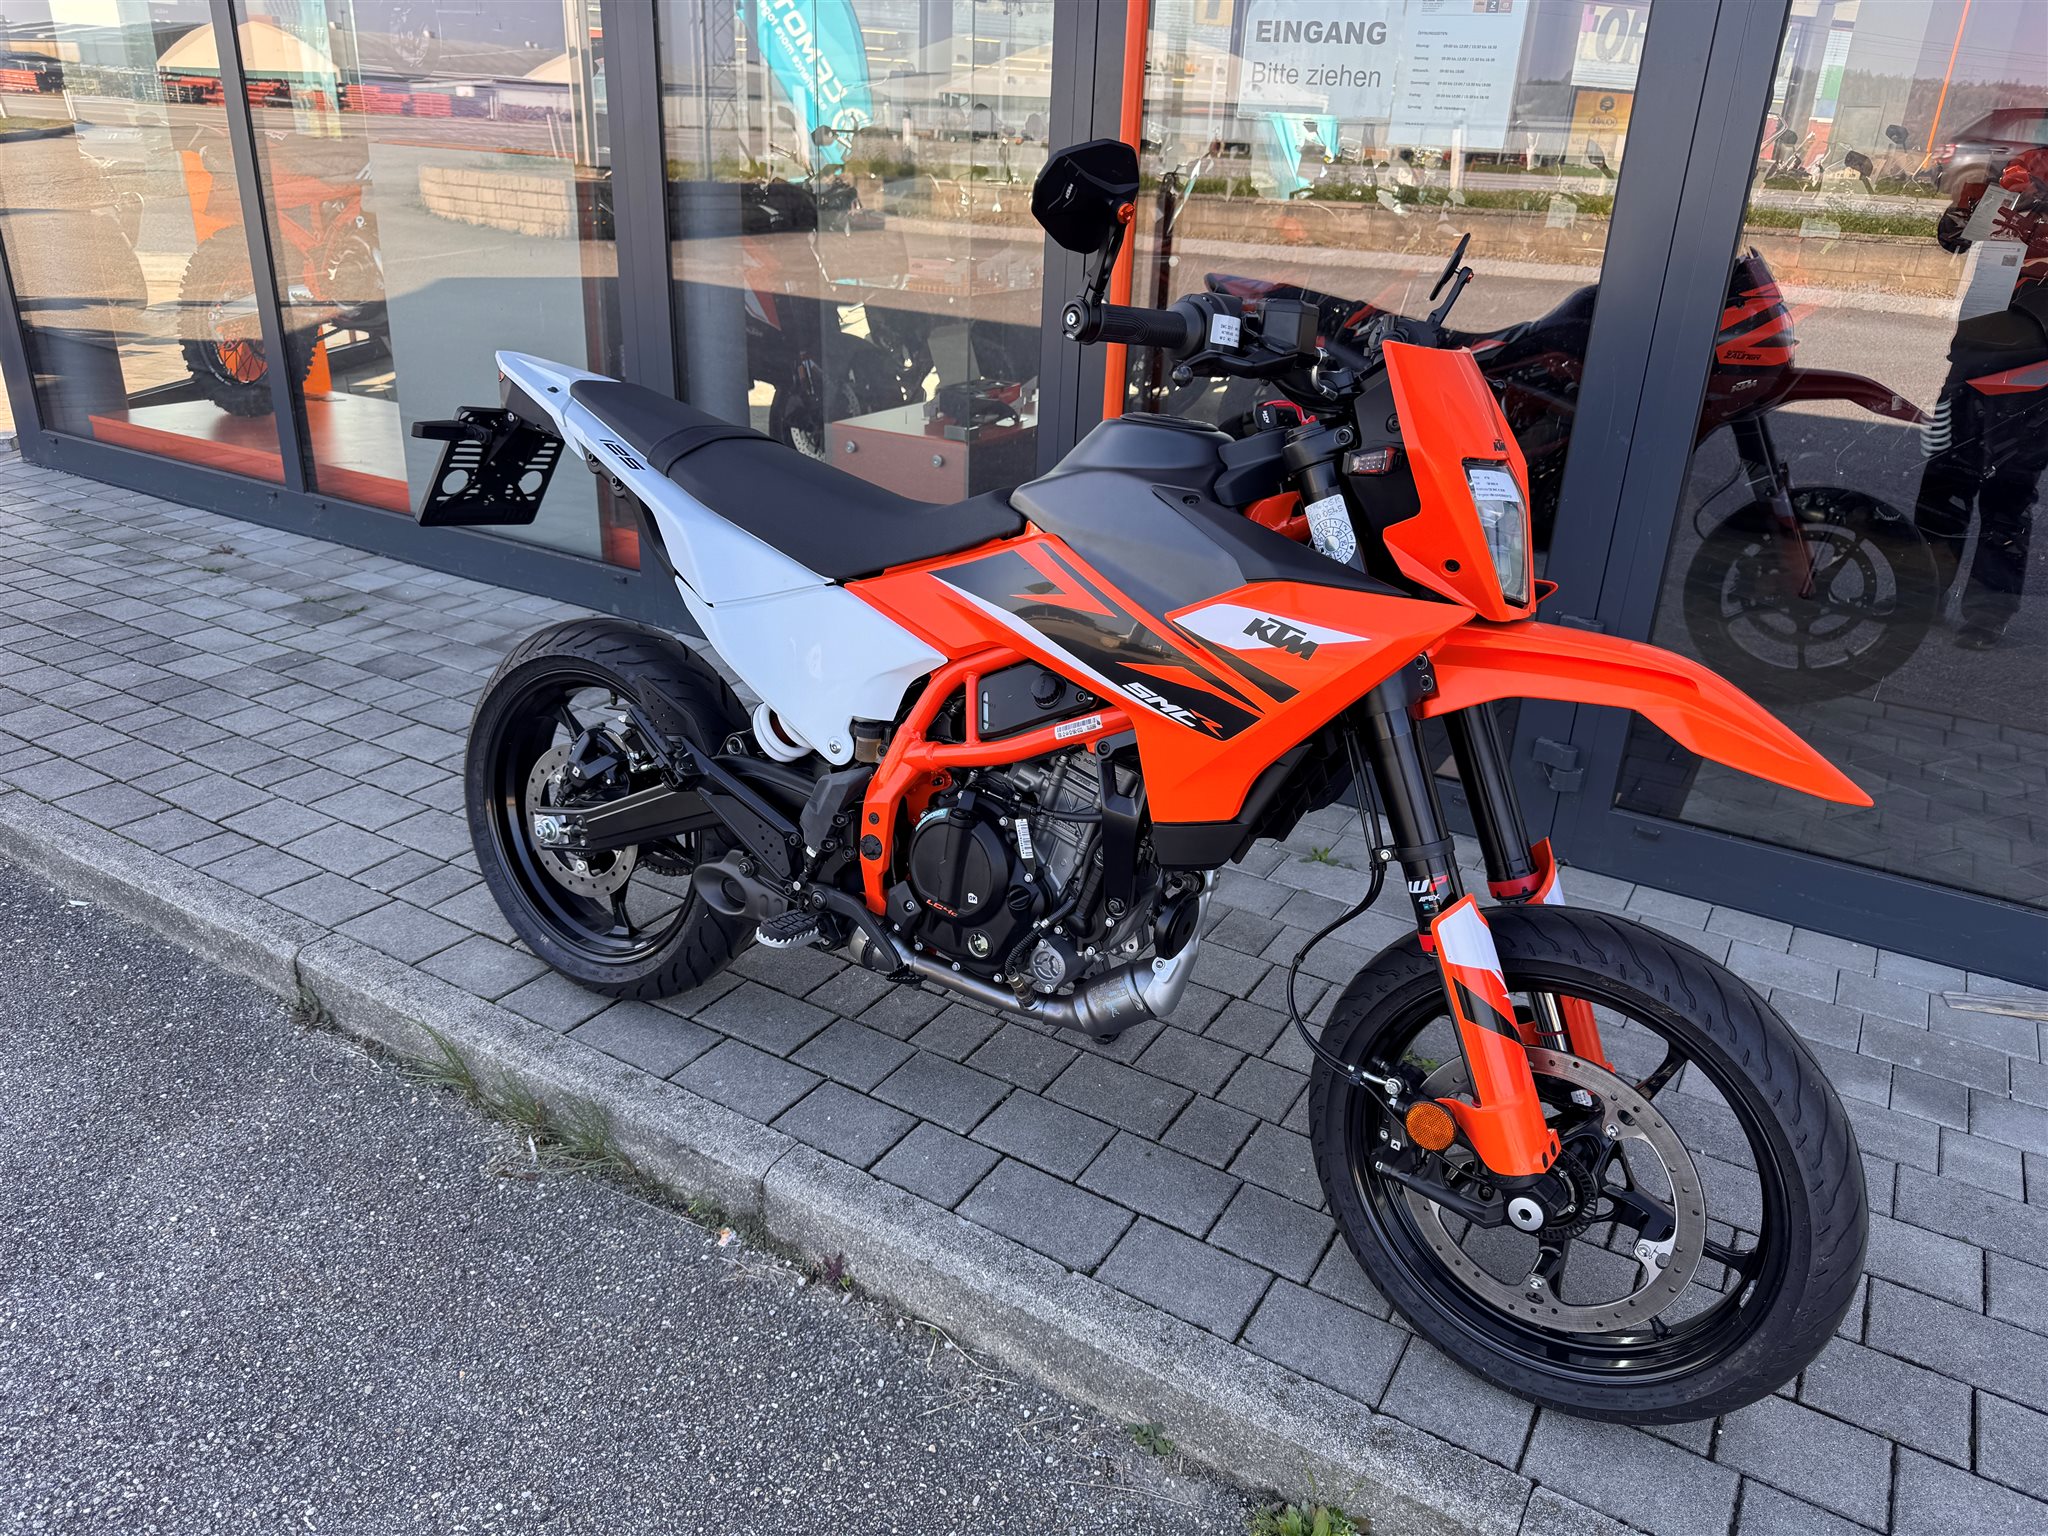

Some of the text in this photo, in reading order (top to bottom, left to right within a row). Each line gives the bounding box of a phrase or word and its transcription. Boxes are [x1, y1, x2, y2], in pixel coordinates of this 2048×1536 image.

[1255, 20, 1387, 45] EINGANG
[1251, 61, 1382, 88] Bitte ziehen
[1243, 617, 1319, 661] KTM
[968, 894, 977, 902] OK
